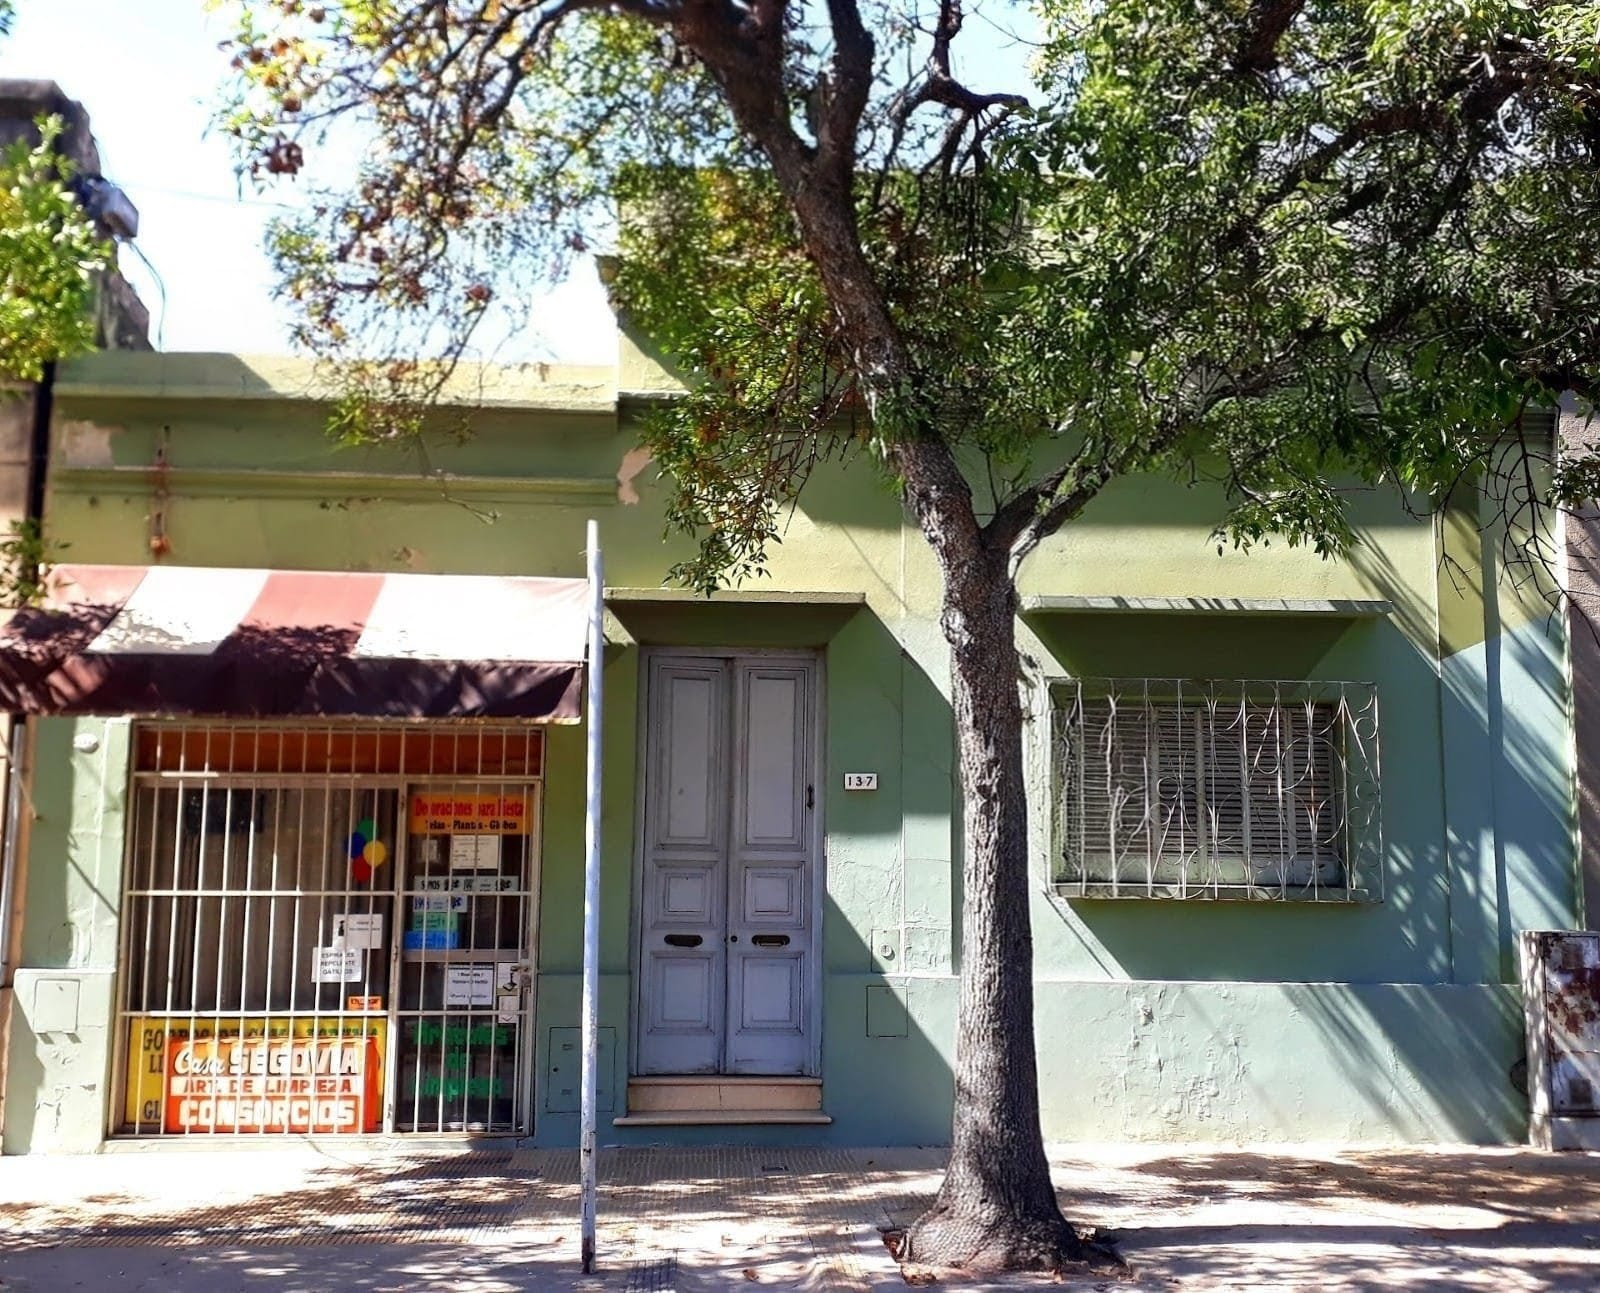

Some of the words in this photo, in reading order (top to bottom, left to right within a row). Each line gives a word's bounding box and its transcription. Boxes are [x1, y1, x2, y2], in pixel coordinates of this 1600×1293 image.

[848, 776, 873, 786] 137
[415, 798, 472, 817] Deoraciones
[425, 820, 445, 829] elas
[453, 820, 482, 829] Plants
[489, 820, 517, 829] Glbos
[229, 1046, 359, 1074] SEGOVIA
[184, 1080, 222, 1093] ART.
[230, 1080, 253, 1093] DE
[265, 1080, 352, 1093] LIMPEZA
[179, 1099, 356, 1125] CONSORCIOS
